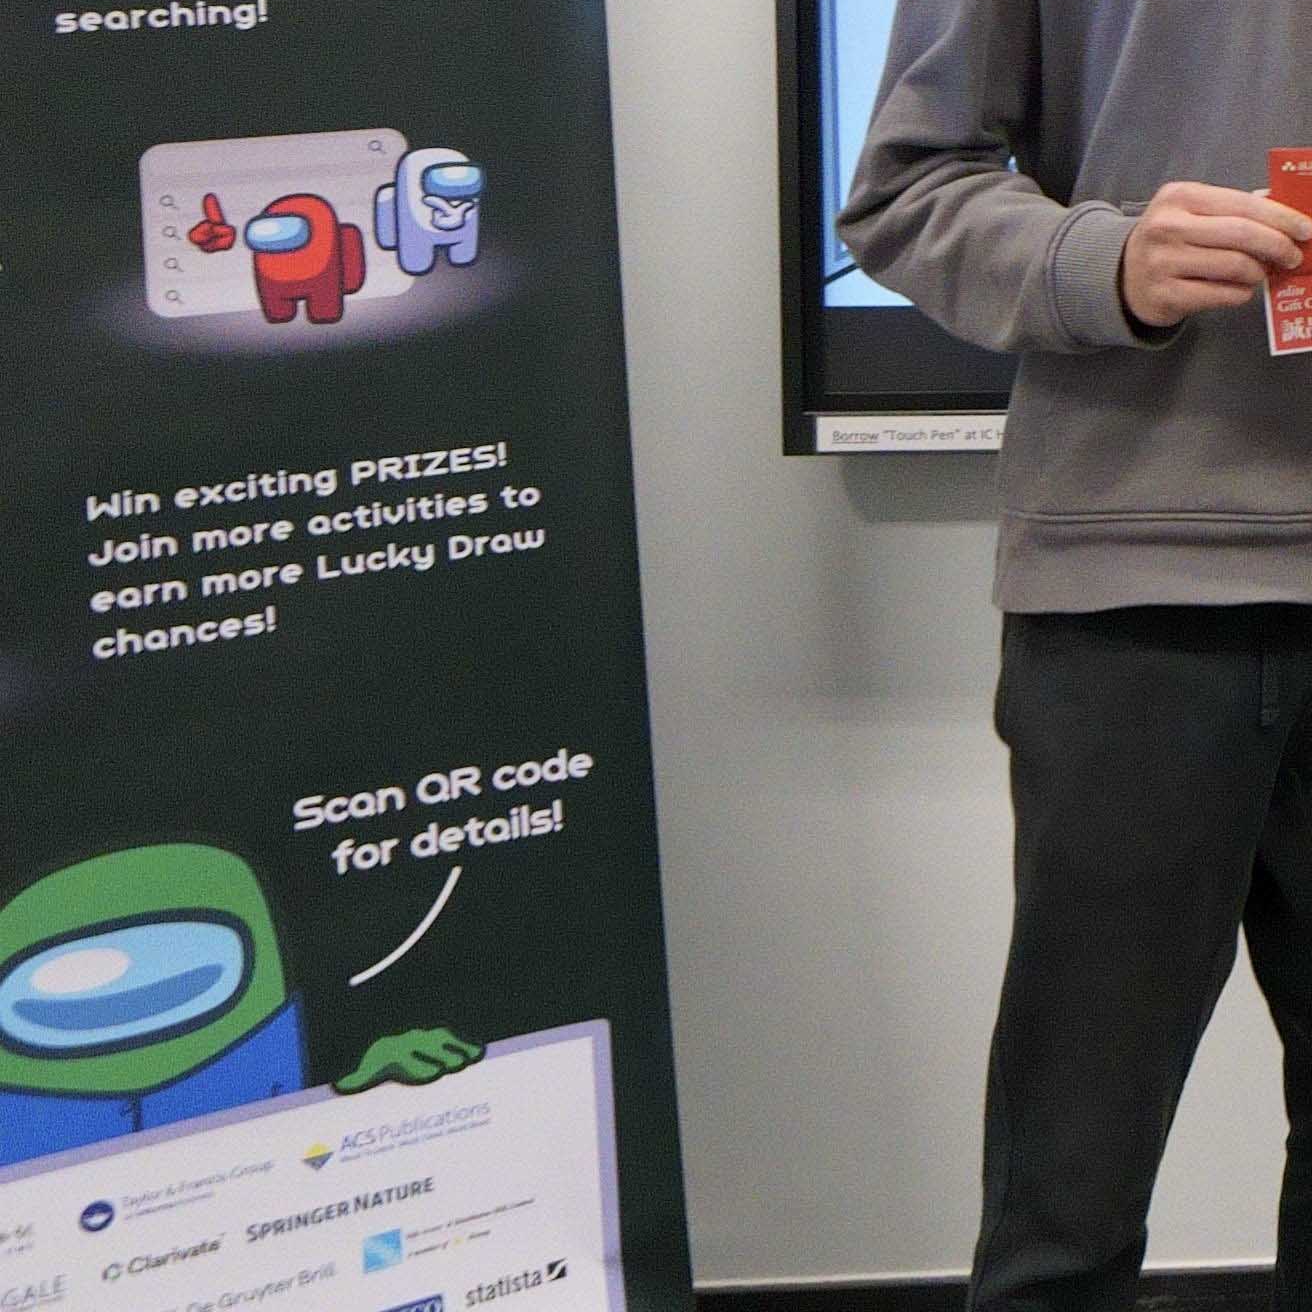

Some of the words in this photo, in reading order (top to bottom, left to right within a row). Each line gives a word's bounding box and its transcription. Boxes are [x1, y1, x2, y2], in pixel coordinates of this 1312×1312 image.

[1277, 298, 1304, 312] Gift
[831, 429, 879, 443] Borrow
[965, 429, 977, 440] at
[86, 490, 161, 522] Win
[173, 465, 338, 512] exciting
[350, 441, 508, 486] PRIZES!
[88, 535, 179, 568] Join
[192, 515, 295, 554] more
[306, 489, 489, 538] activities
[500, 483, 542, 511] to
[89, 577, 188, 614] earn
[201, 560, 304, 598] more
[316, 537, 437, 580] Lucky
[447, 525, 547, 561] Draw
[91, 604, 278, 660] chances!
[292, 781, 406, 833] Scan
[416, 765, 482, 803] QR
[491, 746, 595, 791] code
[330, 836, 396, 876] for
[408, 798, 564, 862] details!
[339, 1125, 378, 1153] ACS
[378, 1101, 490, 1141] Publications
[246, 1202, 350, 1244] SPRINGER
[351, 1176, 435, 1215] NATURE
[127, 1237, 223, 1275] Clarivate
[465, 1269, 543, 1307] statista
